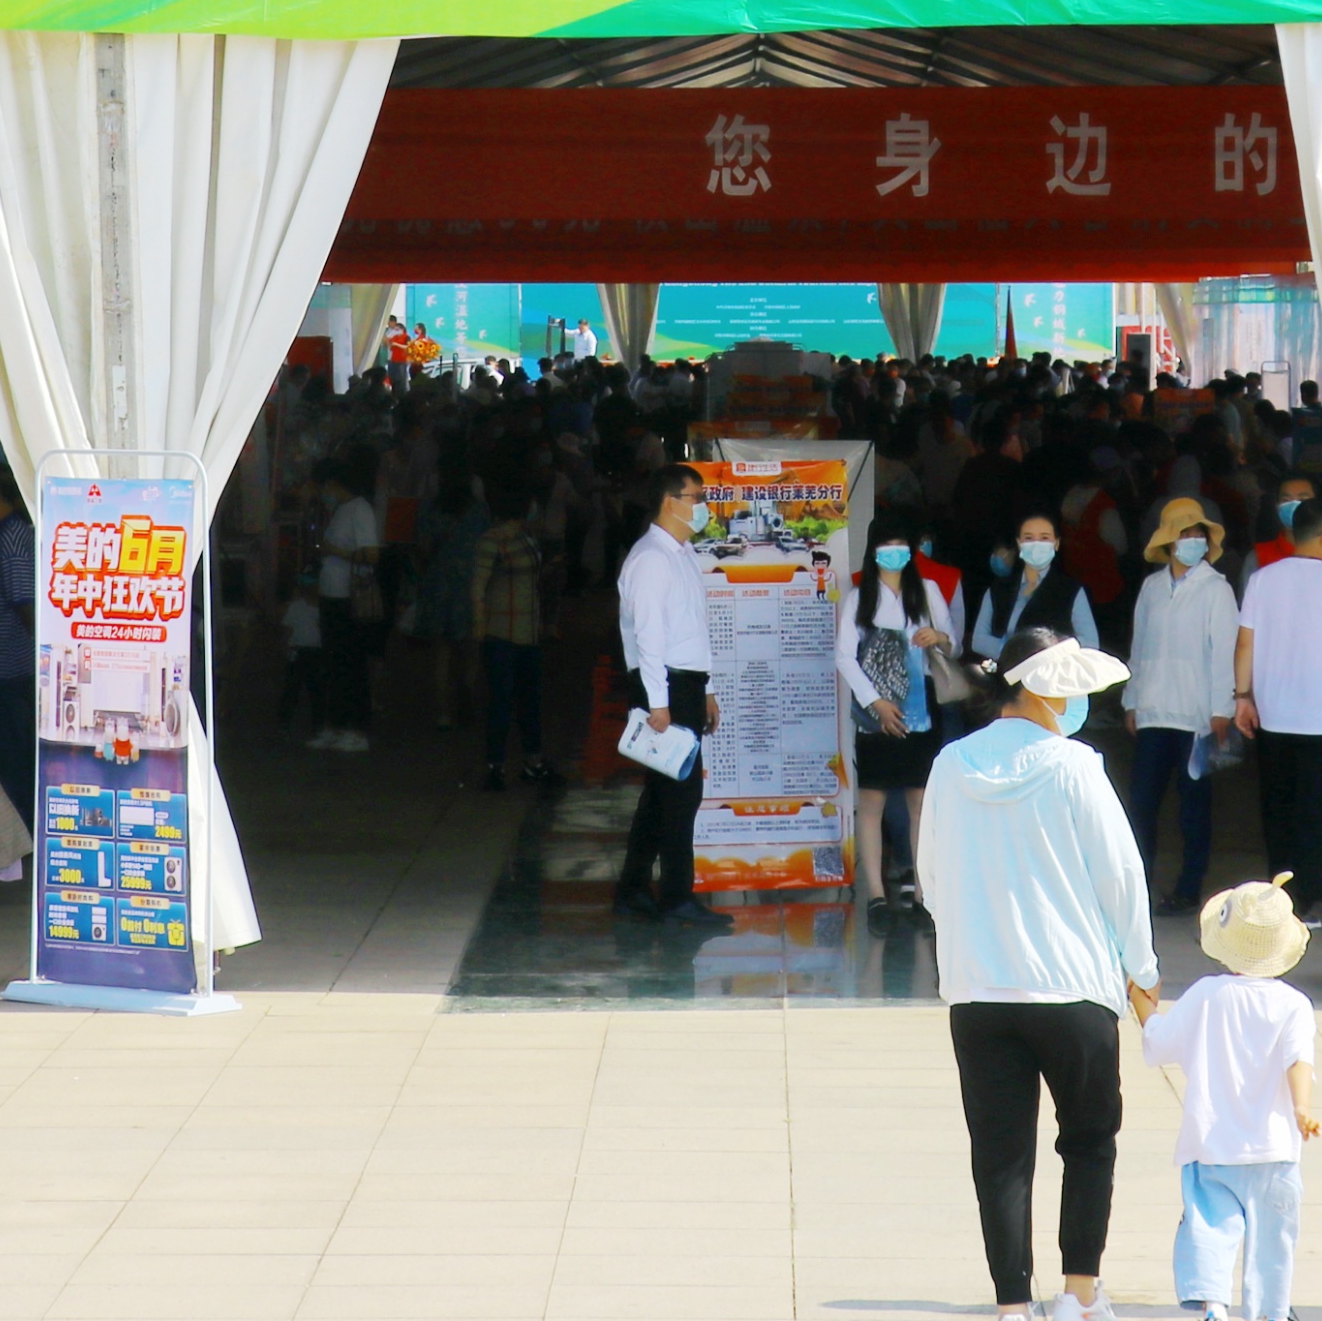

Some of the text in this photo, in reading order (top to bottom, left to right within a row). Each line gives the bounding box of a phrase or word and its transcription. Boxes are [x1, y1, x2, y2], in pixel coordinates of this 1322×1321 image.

[704, 112, 1278, 198] 您身边的
[741, 484, 843, 502] 建设银行莱芜分行
[51, 573, 185, 616] 年中狂欢节
